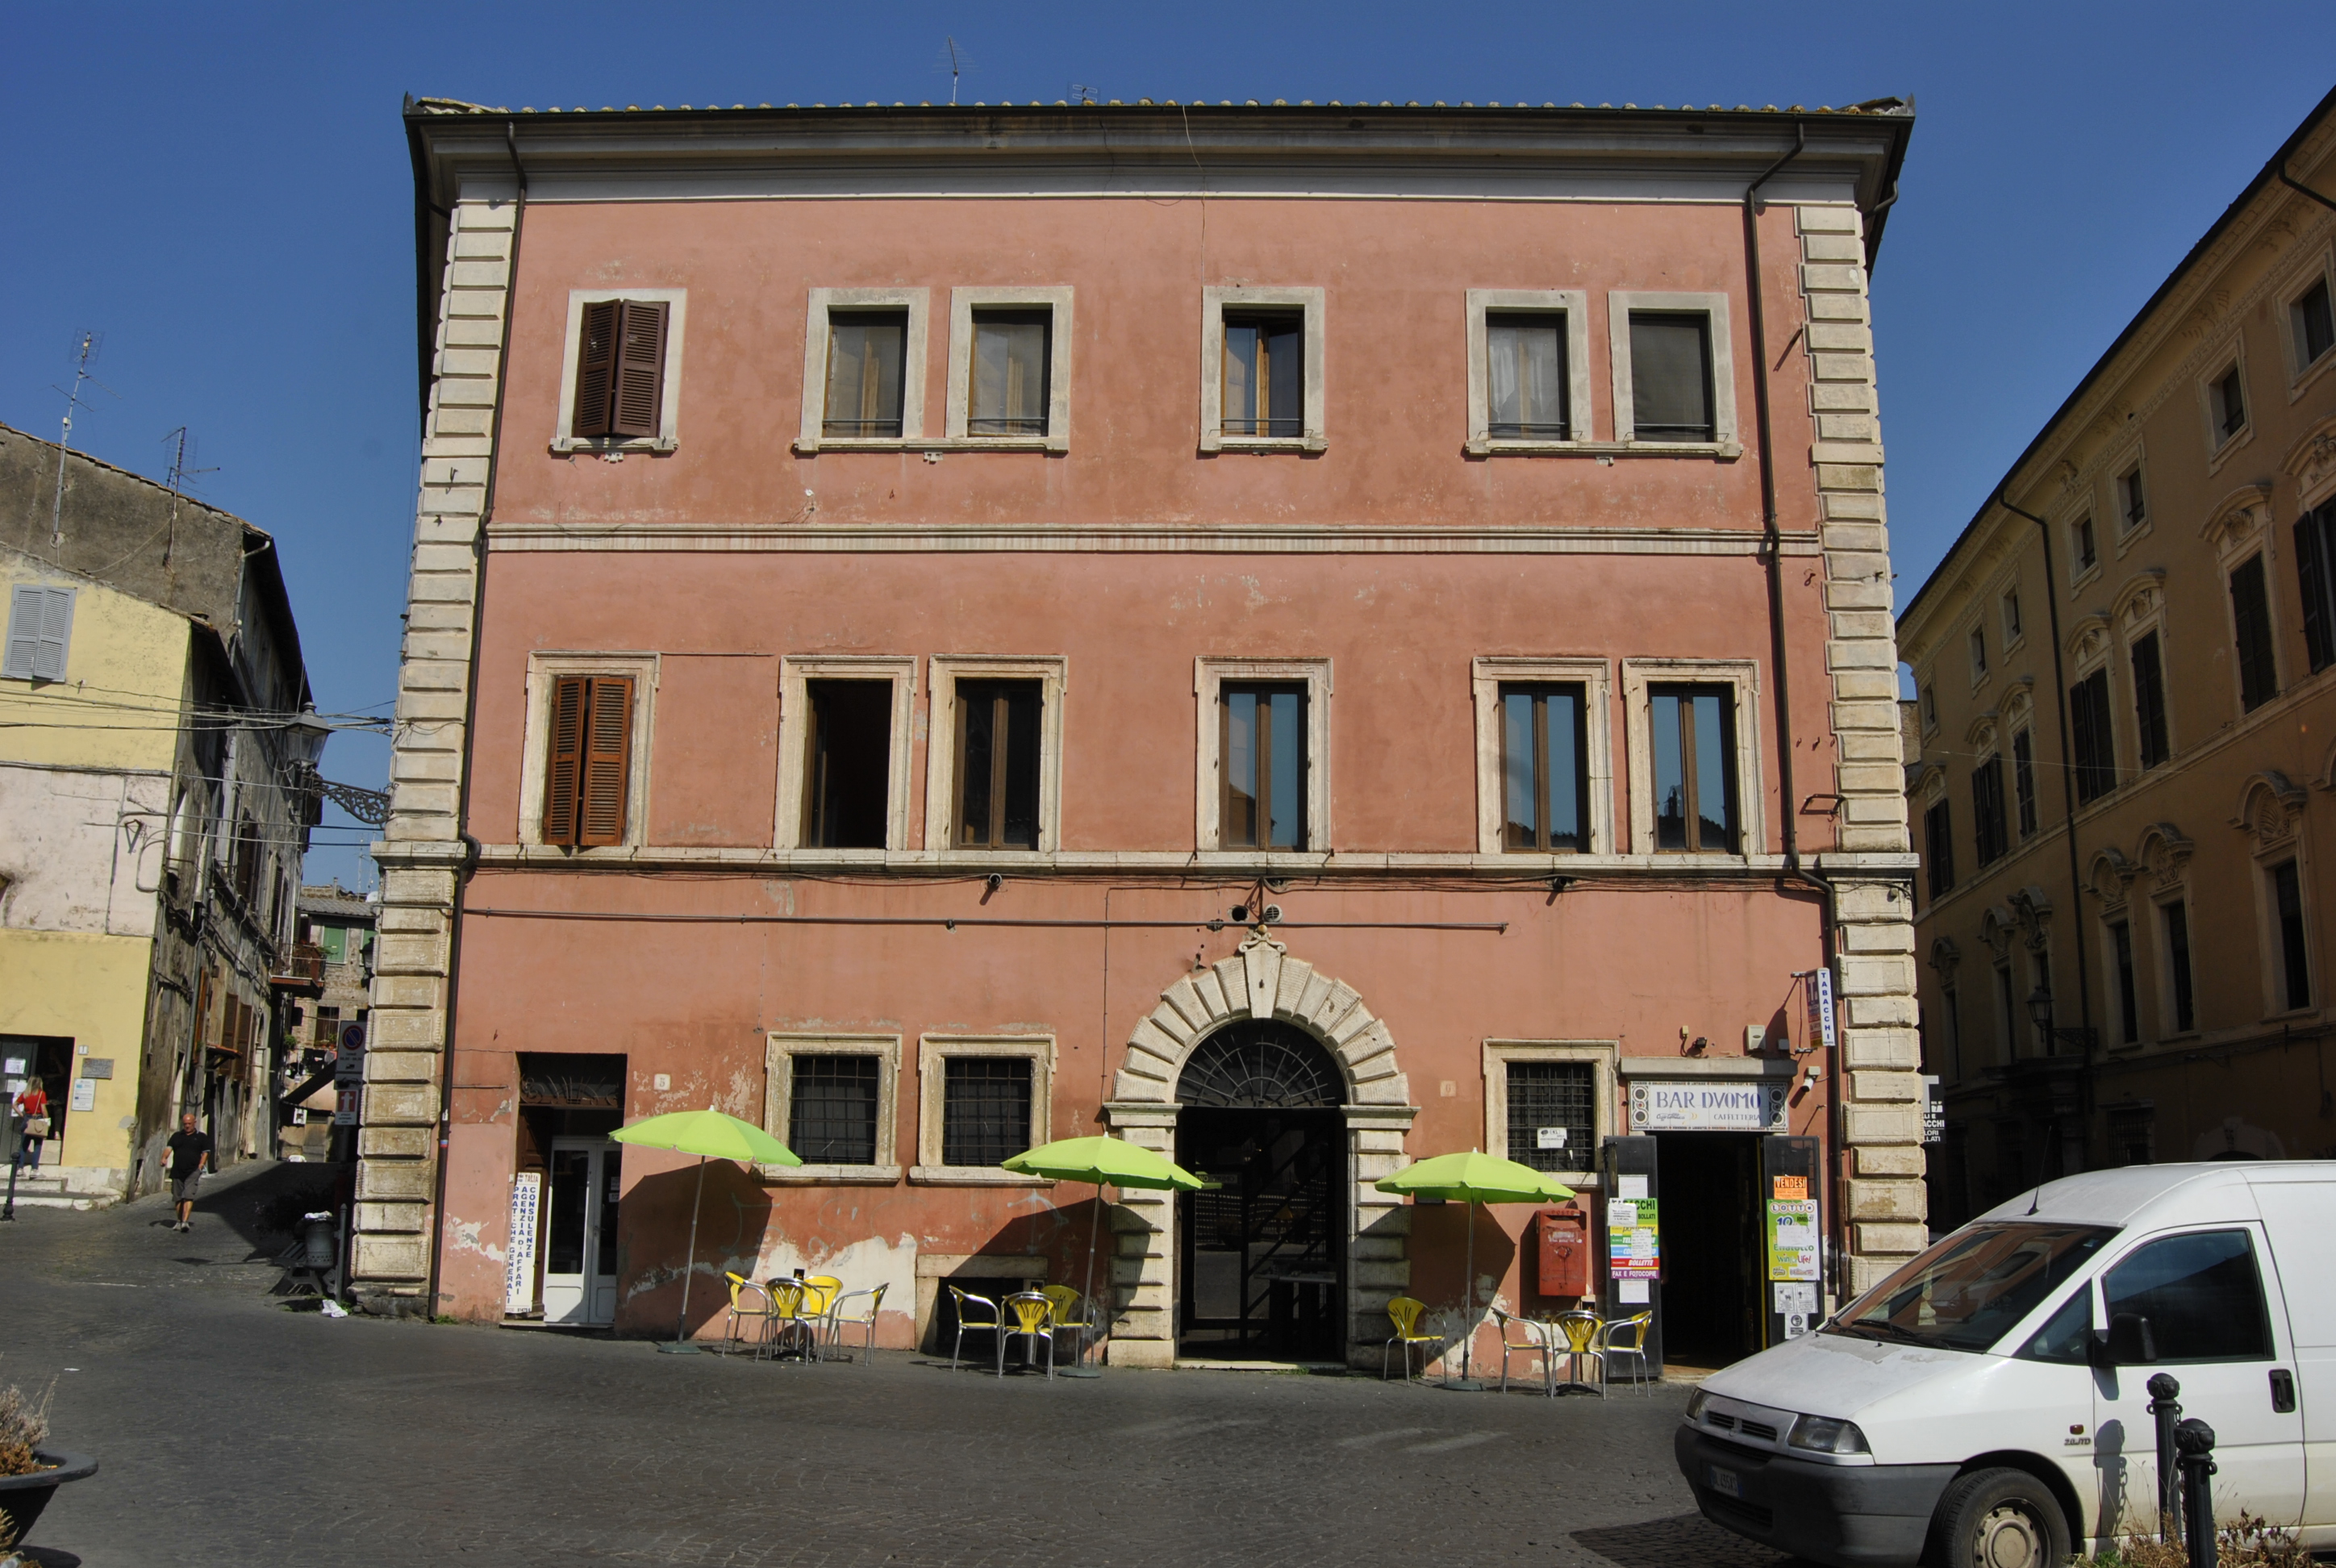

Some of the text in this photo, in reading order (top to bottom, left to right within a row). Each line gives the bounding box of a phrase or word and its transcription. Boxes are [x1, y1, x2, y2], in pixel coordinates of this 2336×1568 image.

[1821, 973, 1830, 1039] TABACCHI
[1656, 1091, 1761, 1109] BAR DVOMO
[1775, 1178, 1806, 1188] VENDESI
[511, 1186, 519, 1243] PRATCHE
[519, 1186, 528, 1236] AGENZIA
[526, 1186, 536, 1257] CONSULENZE
[507, 1247, 515, 1303] GENERALI
[1797, 1255, 1811, 1264] Life!
